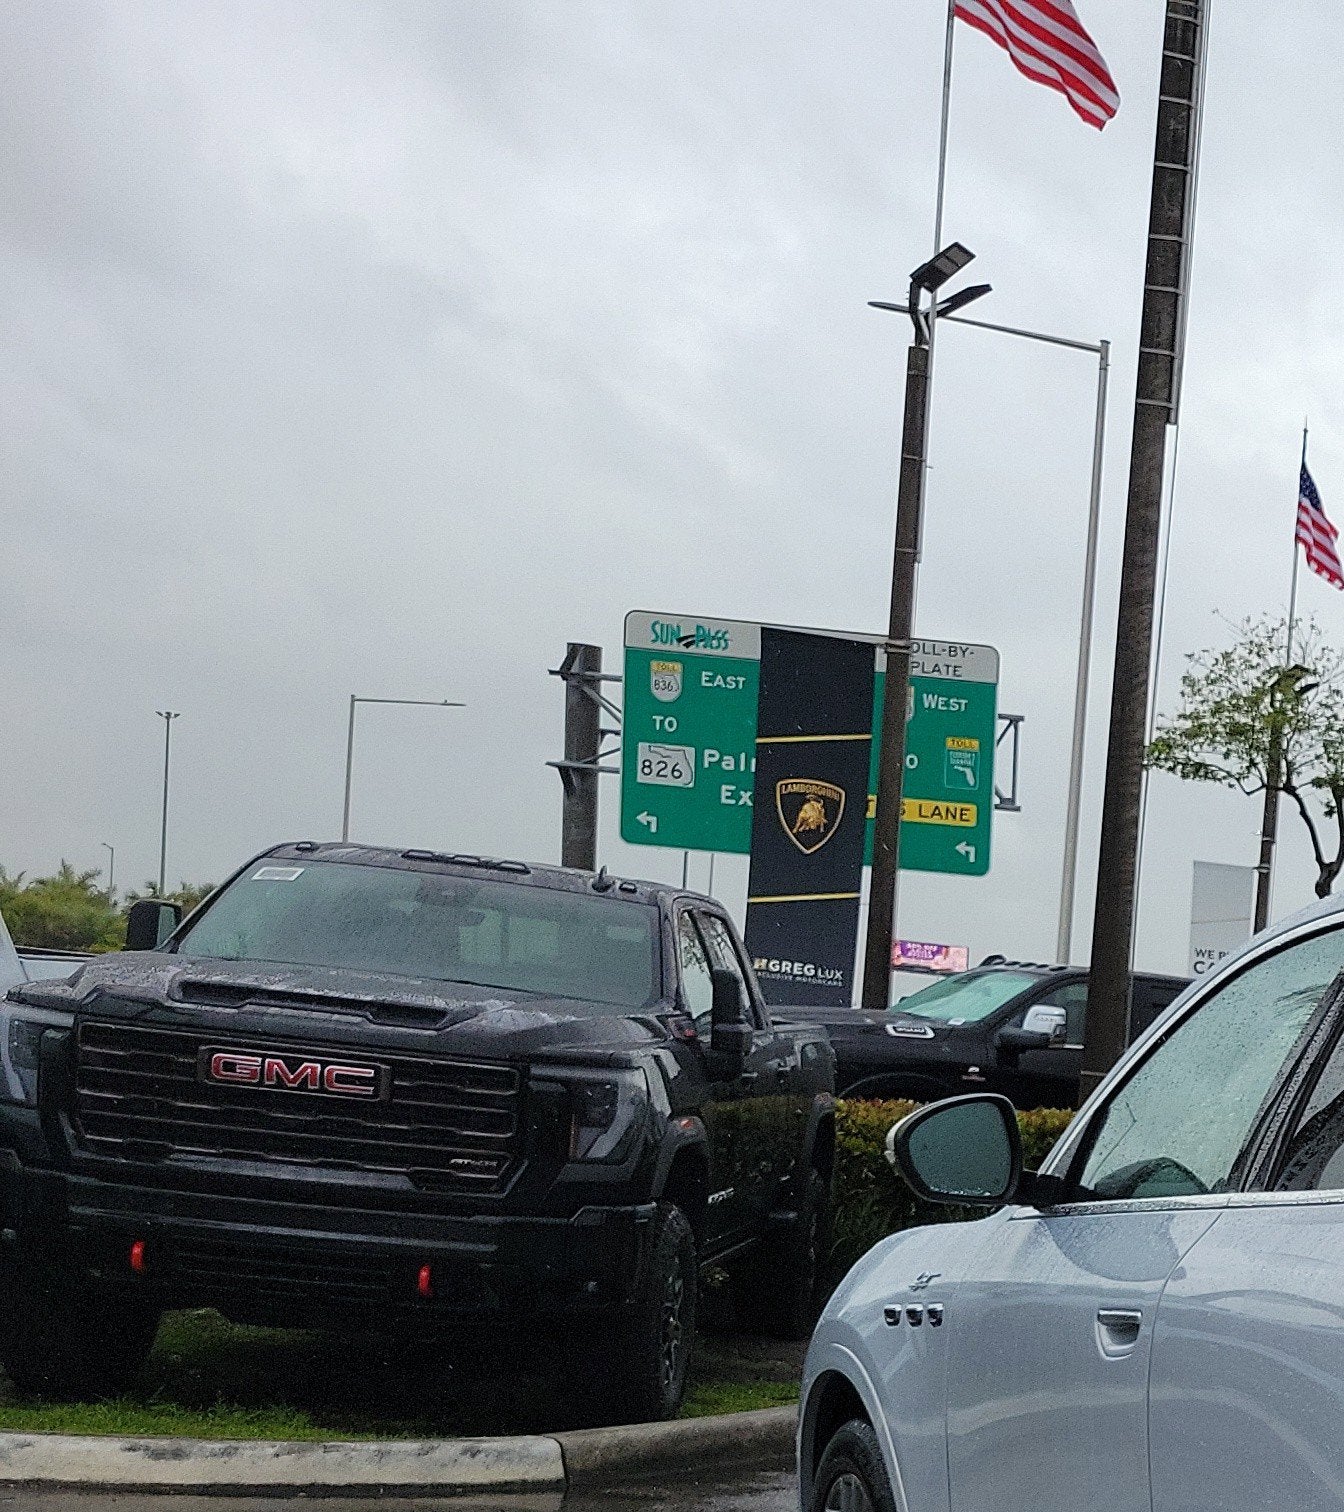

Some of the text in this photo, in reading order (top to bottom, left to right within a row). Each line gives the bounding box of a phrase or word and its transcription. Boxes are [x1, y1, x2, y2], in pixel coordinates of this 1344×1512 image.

[910, 641, 974, 658] OLL-BY-
[910, 661, 963, 677] PLATE
[701, 671, 747, 690] EAST
[922, 693, 969, 712] WEST
[652, 715, 678, 732] TO
[641, 758, 683, 780] 826
[918, 803, 972, 823] LANE
[211, 1053, 375, 1095] GMC
